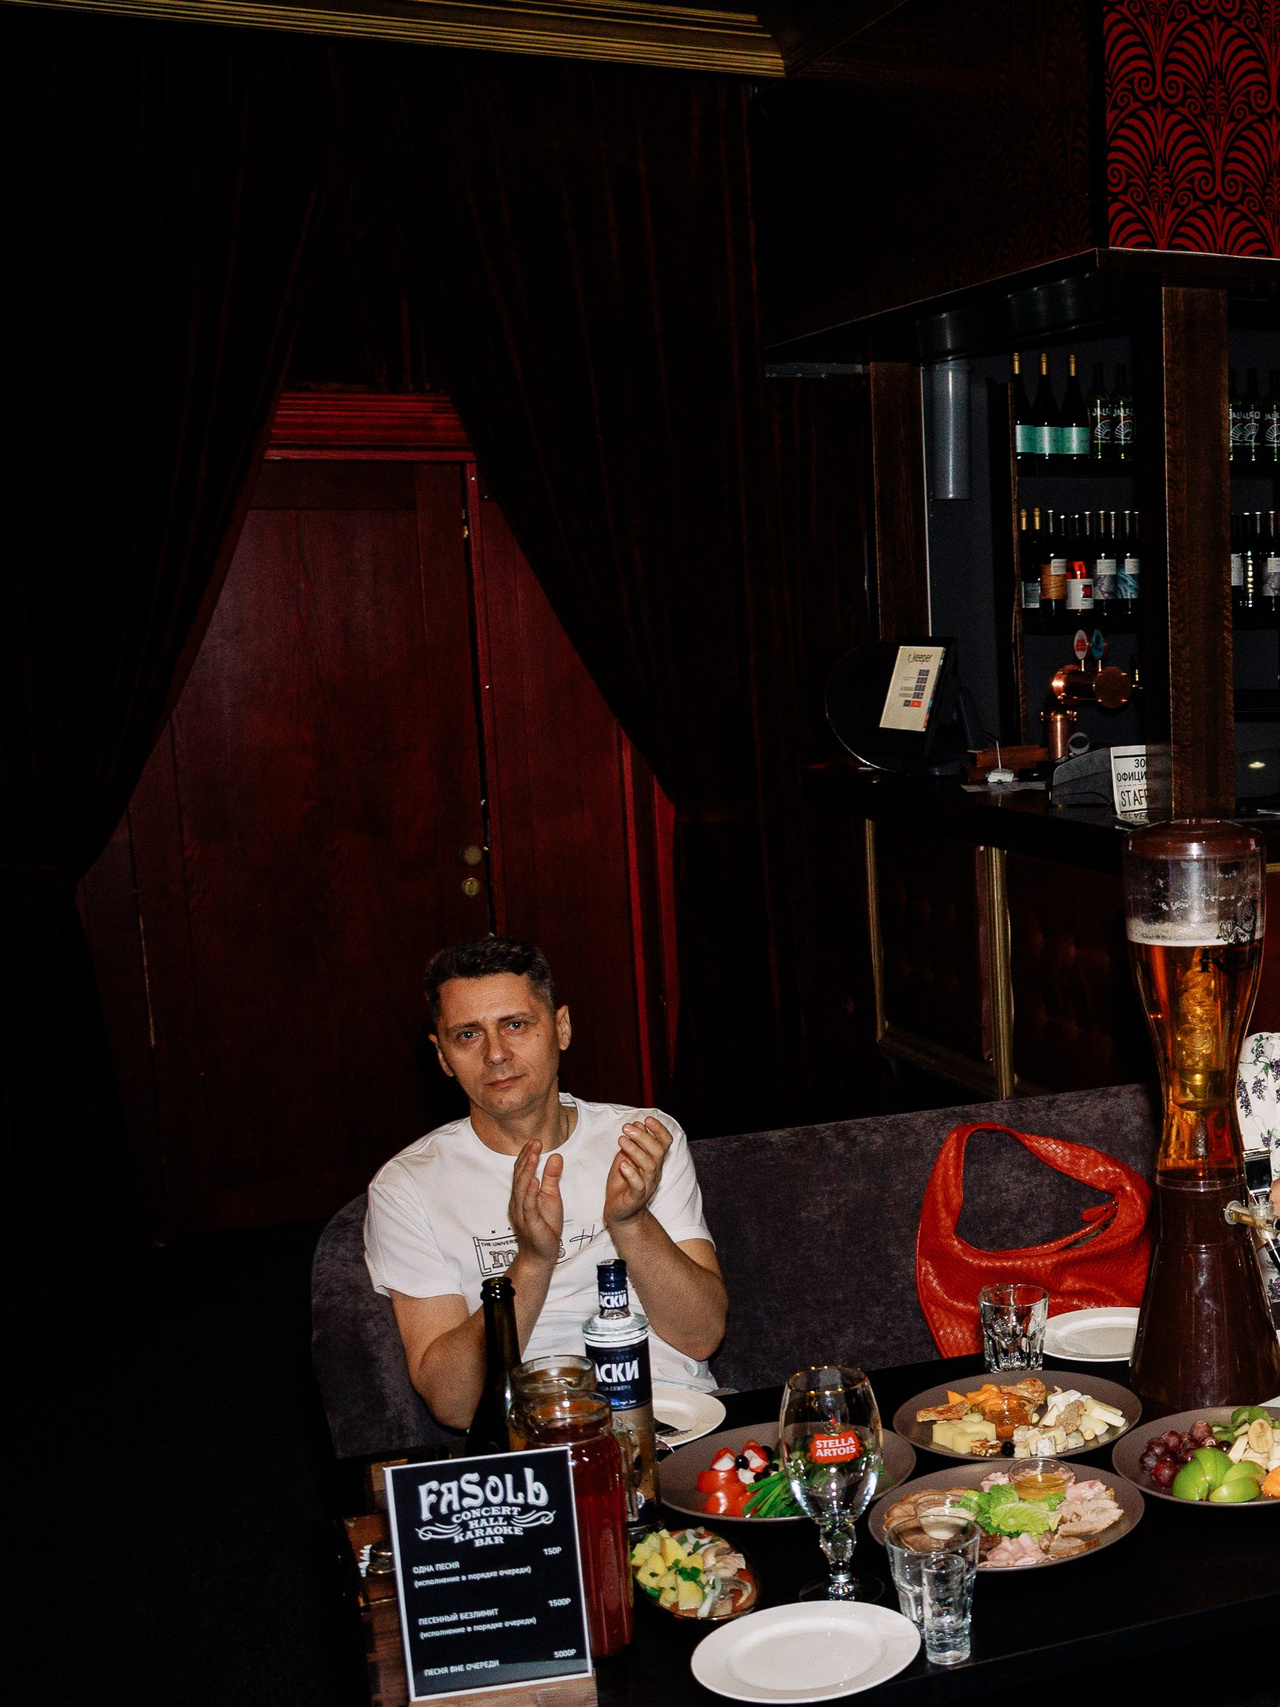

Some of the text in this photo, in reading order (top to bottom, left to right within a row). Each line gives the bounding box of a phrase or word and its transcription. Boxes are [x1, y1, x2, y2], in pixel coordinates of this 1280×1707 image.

[815, 1445, 856, 1457] ARTOIS
[816, 1437, 855, 1448] STELLA
[452, 1506, 521, 1523] CONCERT
[468, 1517, 507, 1530] HALL
[453, 1526, 524, 1544] KARAOKE
[474, 1536, 505, 1548] BAR
[412, 1561, 460, 1575] ОДНА ПЕСНЯ
[414, 1574, 460, 1589] (исполнение
[467, 1571, 498, 1583] порядке
[499, 1565, 532, 1578] очереди)
[418, 1608, 499, 1626] ПЕСЕННЫЙ БЕЗЛИМИТ
[419, 1626, 465, 1640] (исполнение
[473, 1622, 503, 1634] порядке
[504, 1616, 537, 1629] очереди)
[424, 1659, 500, 1677] ПЕСНЯ ВНЕ ОЧЕРЕДИ
